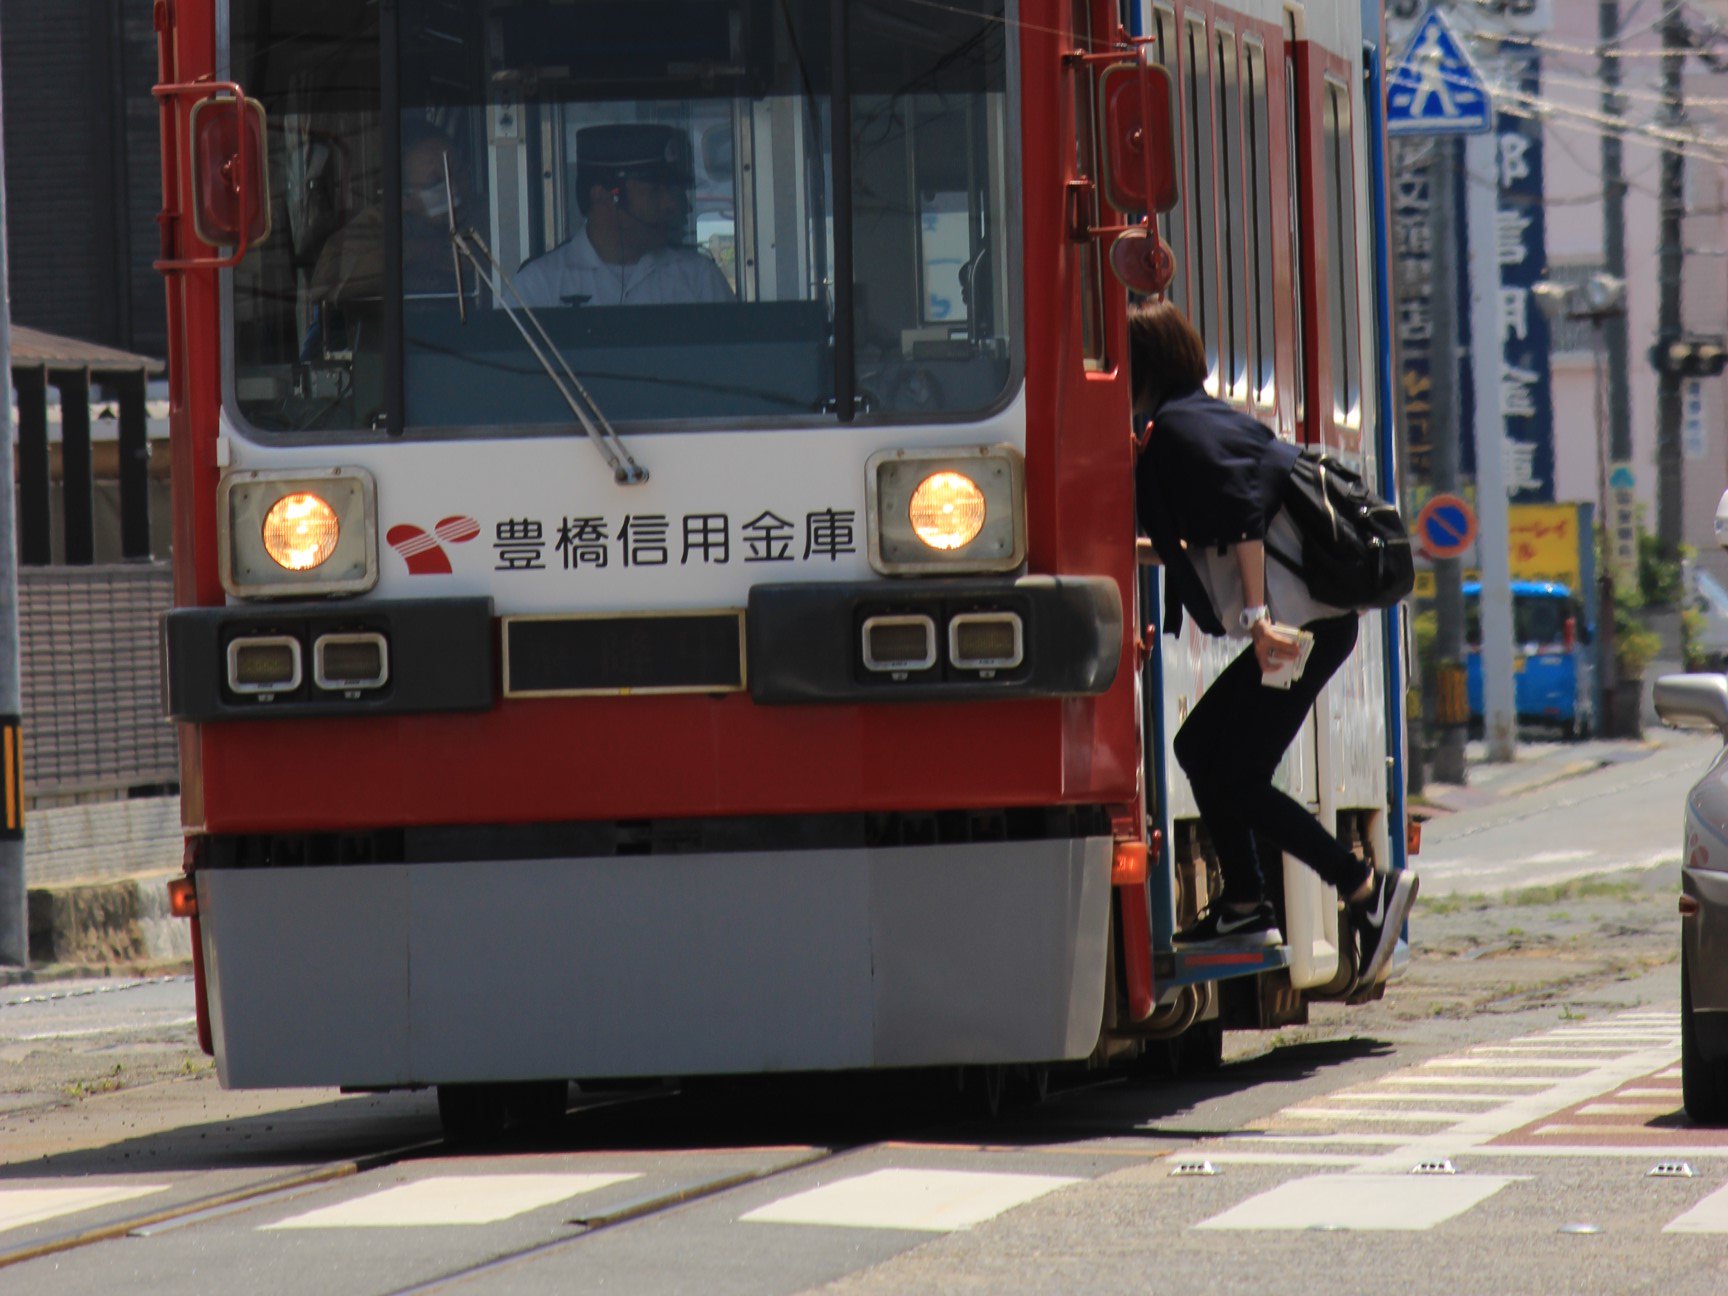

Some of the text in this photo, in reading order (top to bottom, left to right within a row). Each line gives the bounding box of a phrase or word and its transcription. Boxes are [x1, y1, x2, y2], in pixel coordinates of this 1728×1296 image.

[493, 507, 857, 572] 豊橋信用金庫
